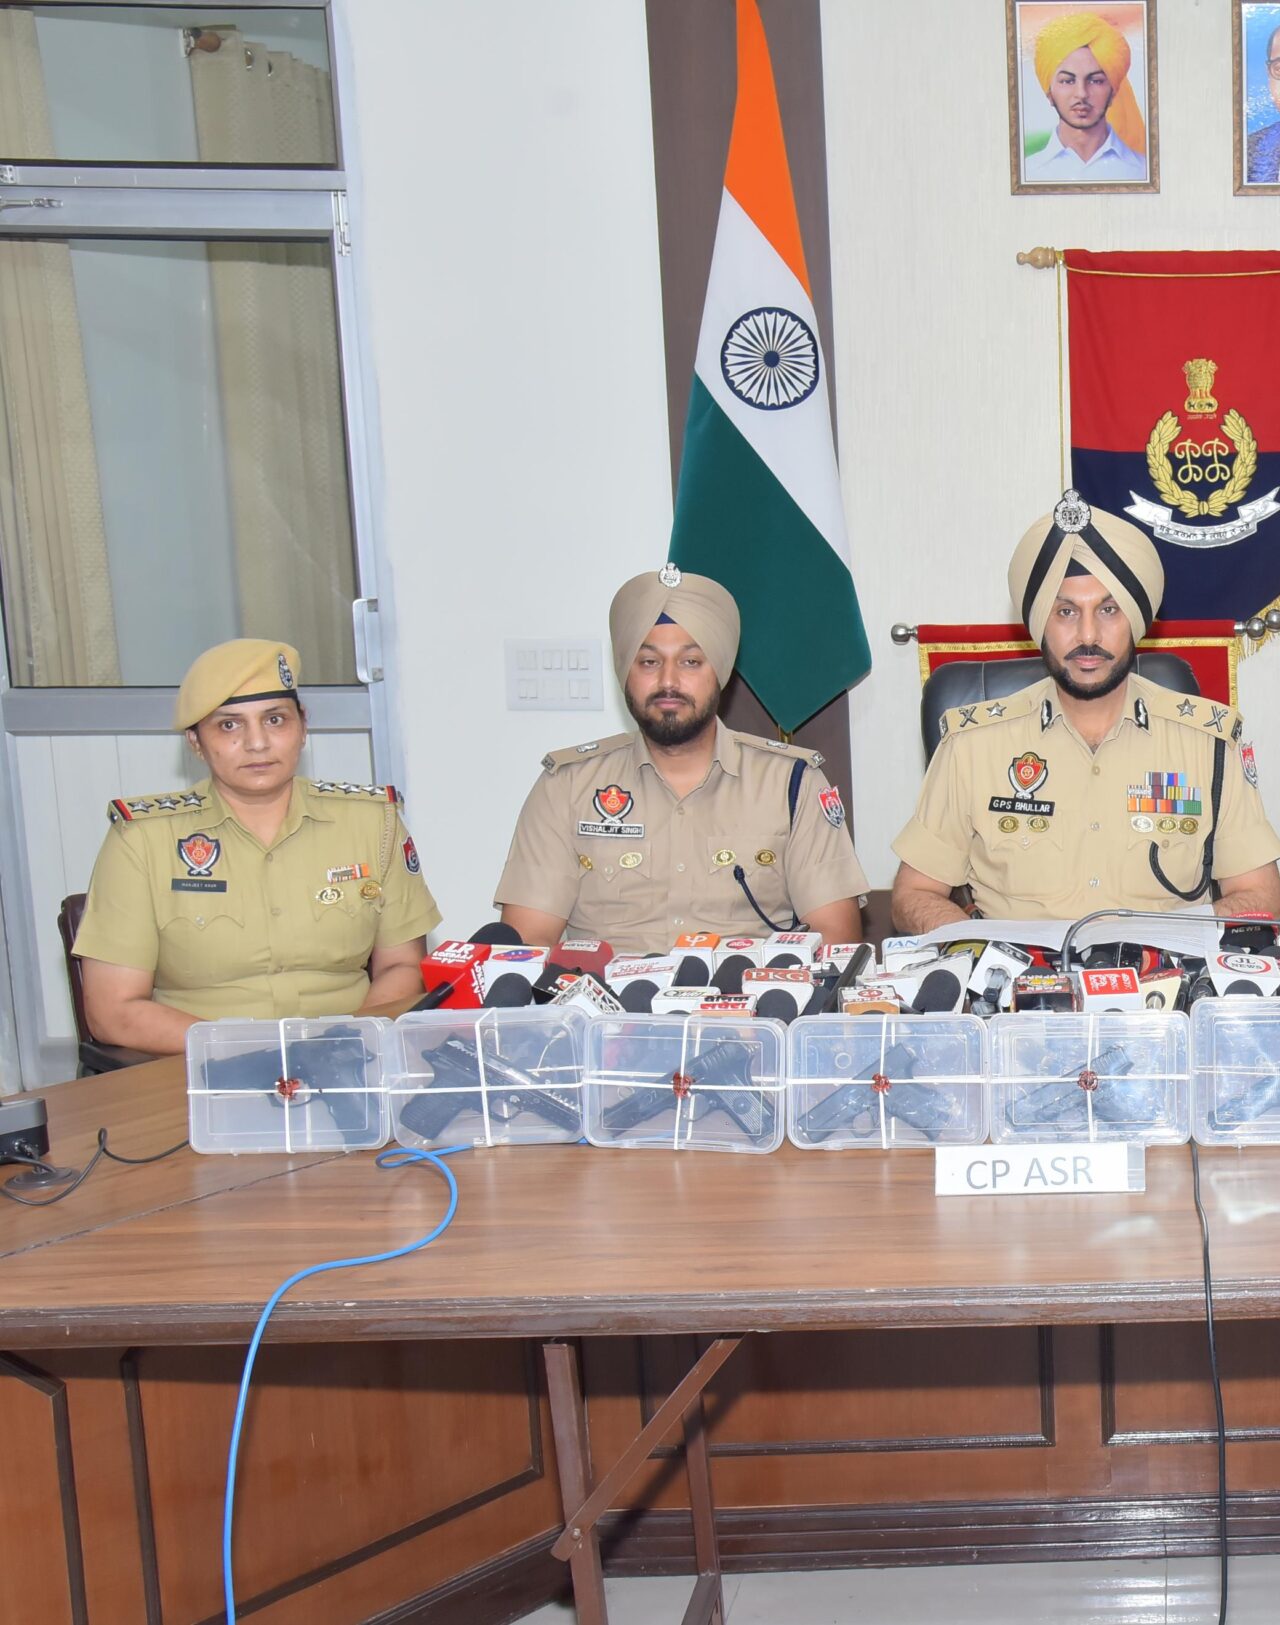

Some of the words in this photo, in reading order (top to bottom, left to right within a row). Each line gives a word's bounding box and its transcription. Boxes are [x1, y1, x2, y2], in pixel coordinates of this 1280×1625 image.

[993, 800, 1012, 810] GPS
[1015, 802, 1050, 812] BHULLAR
[444, 942, 476, 954] LR
[751, 971, 805, 981] PKG
[965, 1160, 1011, 1189] CP
[1023, 1156, 1094, 1187] ASR
